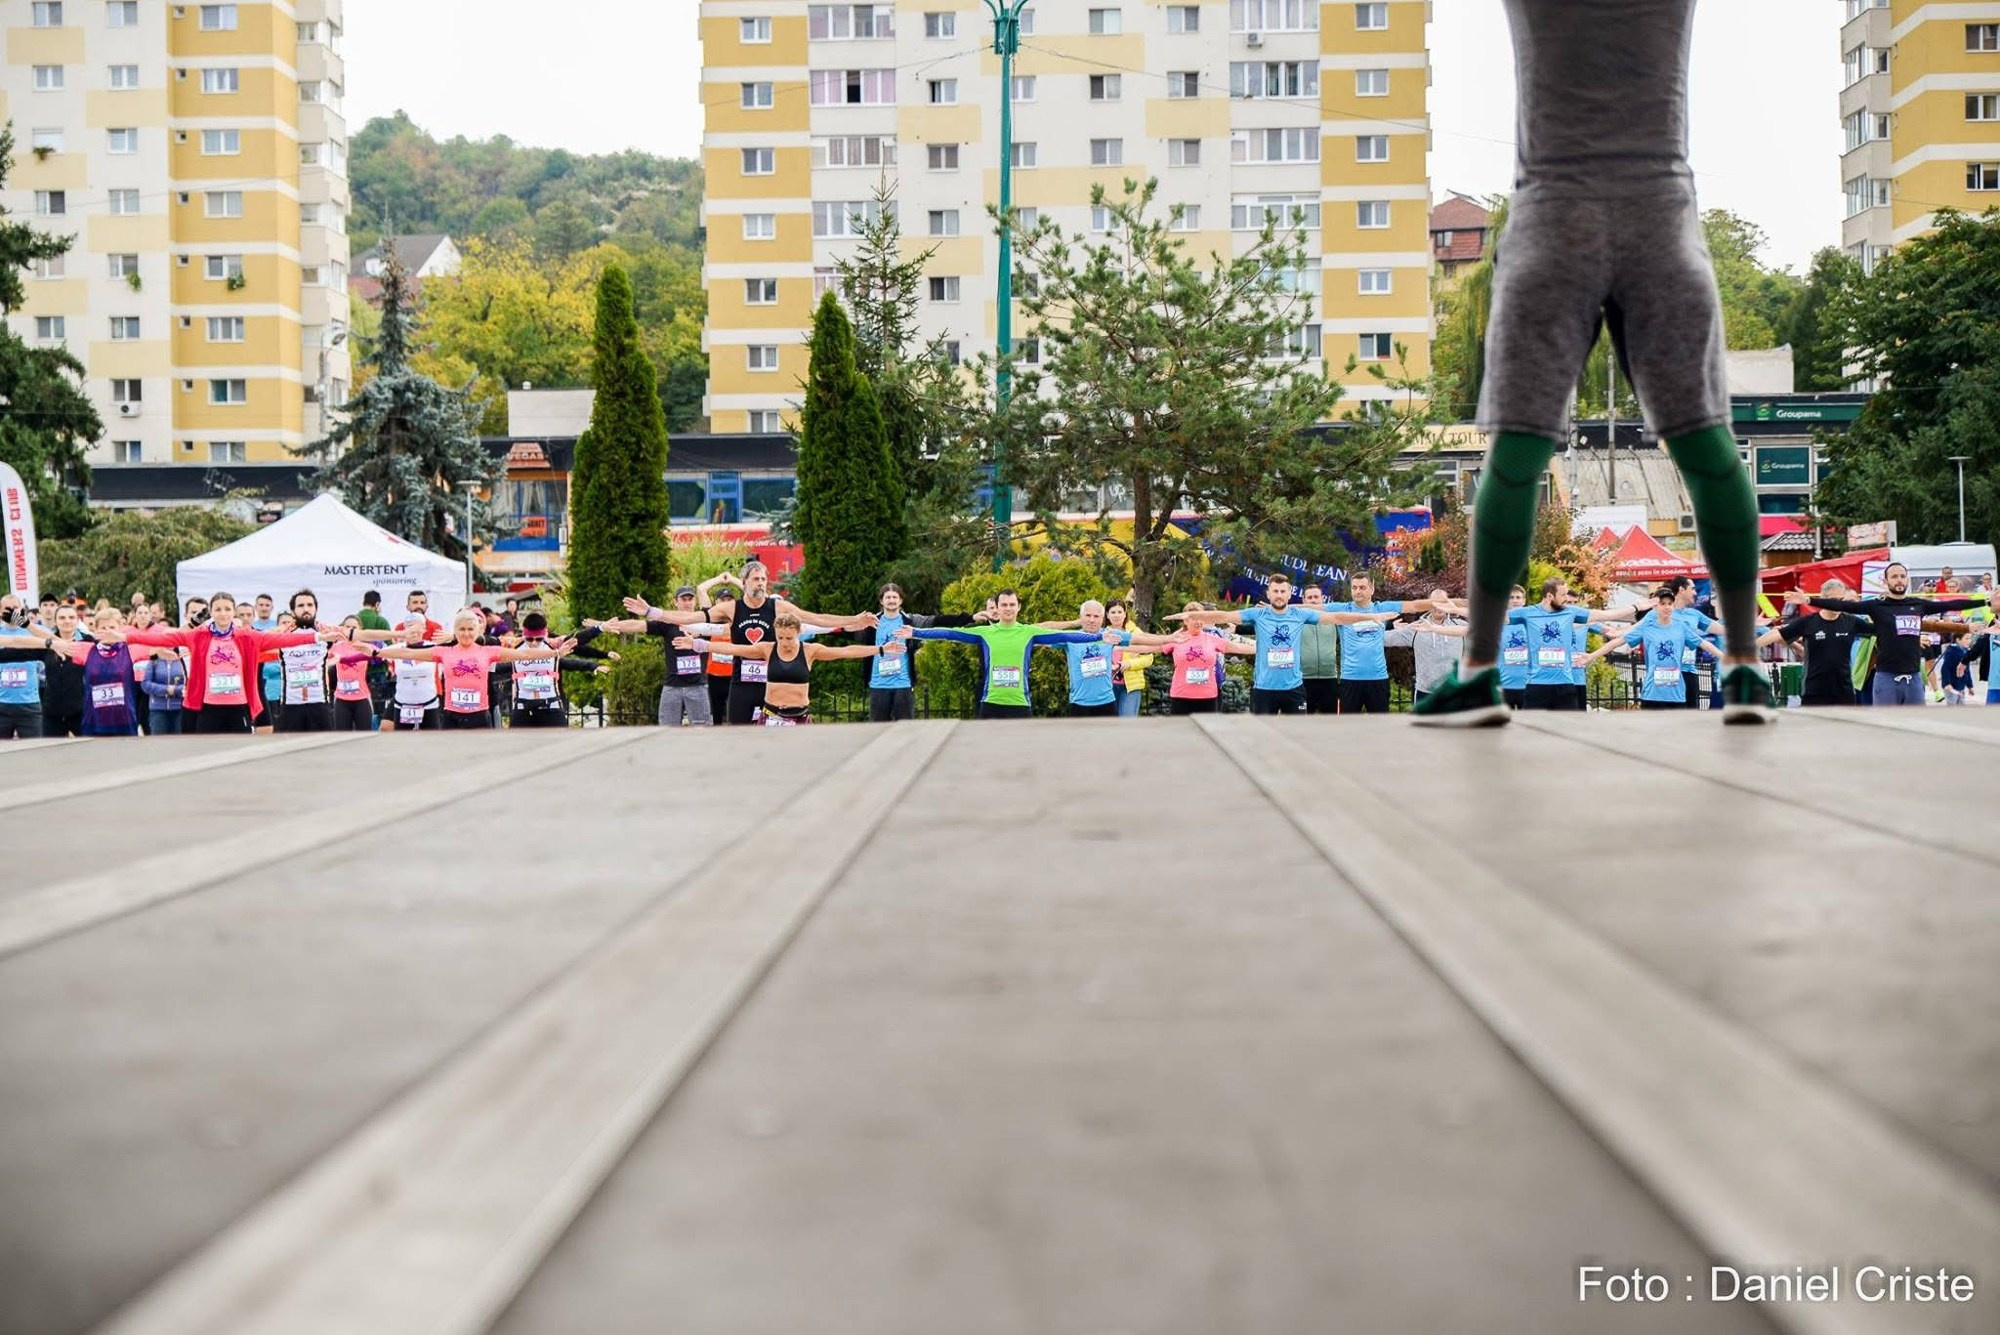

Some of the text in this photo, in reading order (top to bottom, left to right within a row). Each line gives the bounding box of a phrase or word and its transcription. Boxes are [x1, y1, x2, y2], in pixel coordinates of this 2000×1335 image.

[1776, 409, 1822, 419] Groupama
[1450, 431, 1487, 445] TOUR
[1771, 462, 1805, 470] Groupama
[324, 564, 408, 575] MASTERTENT
[1903, 619, 1918, 628] 172
[748, 665, 761, 674] 46
[101, 688, 114, 699] 33
[456, 692, 475, 702] 141
